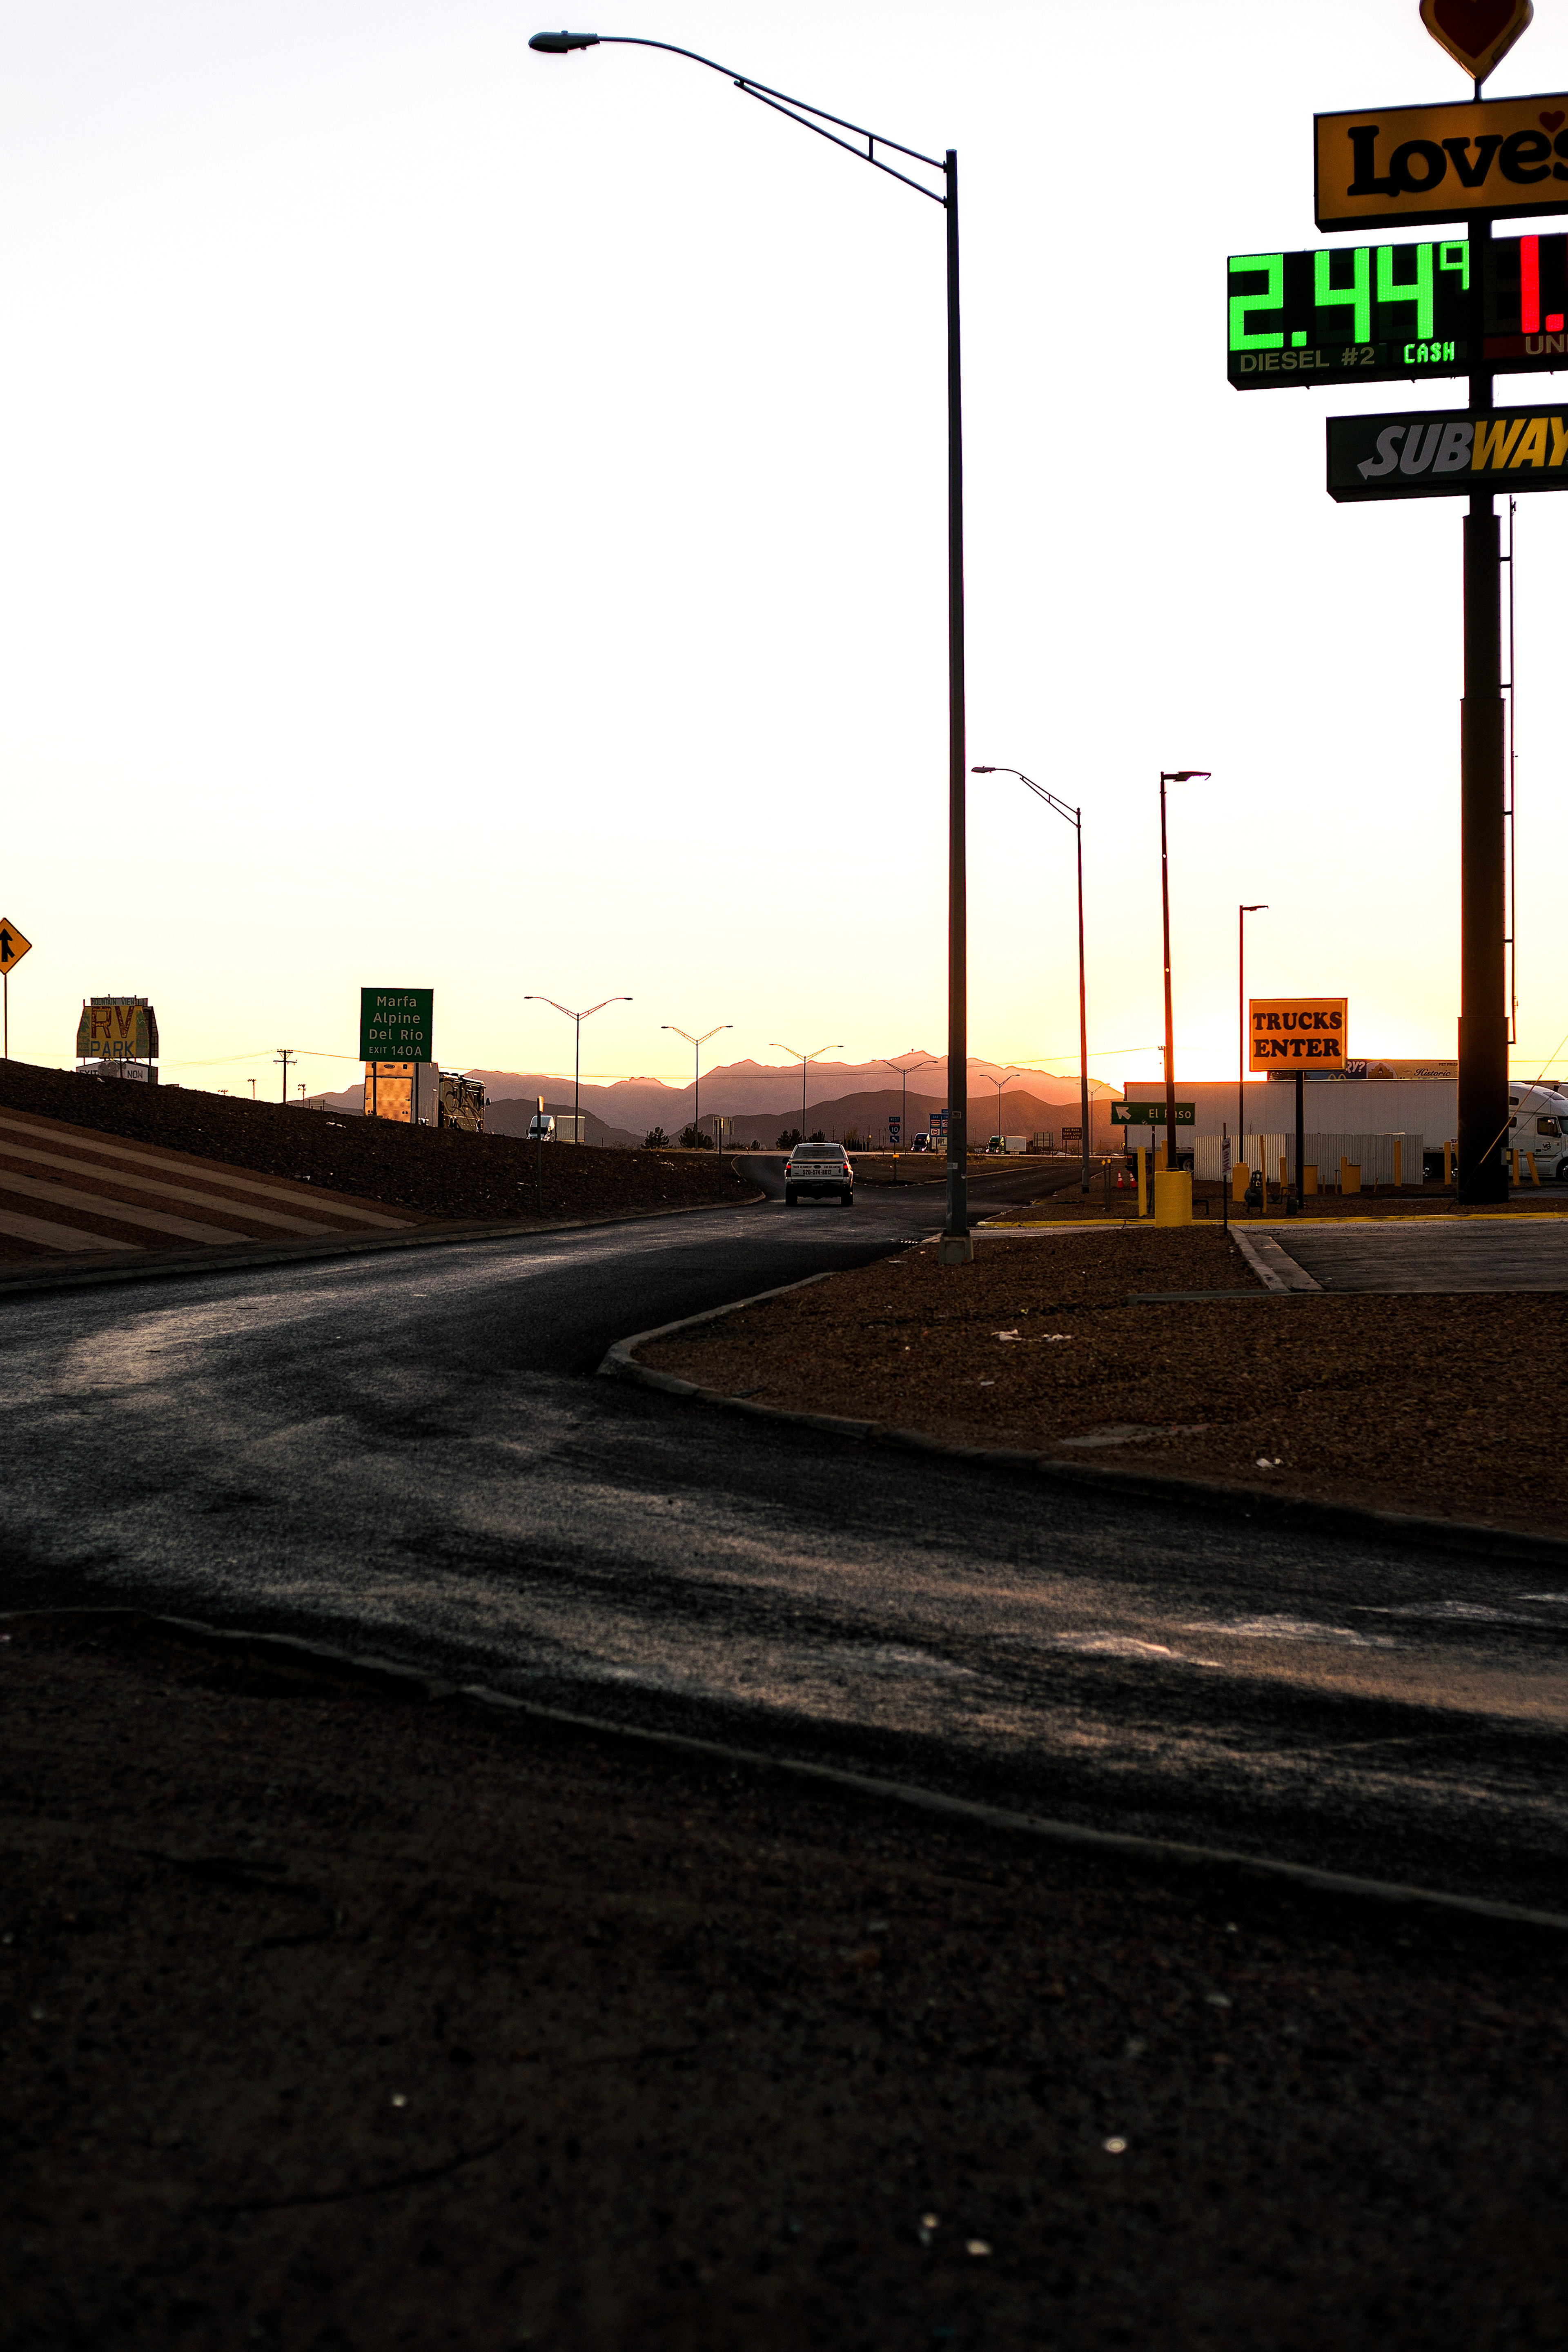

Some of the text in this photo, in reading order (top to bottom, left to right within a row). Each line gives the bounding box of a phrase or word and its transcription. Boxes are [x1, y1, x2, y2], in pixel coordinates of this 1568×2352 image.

[1526, 334, 1568, 354] UN
[1240, 341, 1455, 372] DIESEL #2 CASH
[1356, 416, 1568, 480] SUBWAY
[376, 996, 416, 1007] Marfa
[91, 1006, 134, 1038] RV
[373, 1012, 421, 1026] Alpine
[1252, 1011, 1342, 1030] TRUCKS
[369, 1029, 423, 1040] Del Rio
[90, 1041, 134, 1057] PARK
[391, 1045, 422, 1056] 140A
[1253, 1038, 1341, 1058] ENTER
[127, 1070, 143, 1078] NOW
[1149, 1108, 1159, 1118] El
